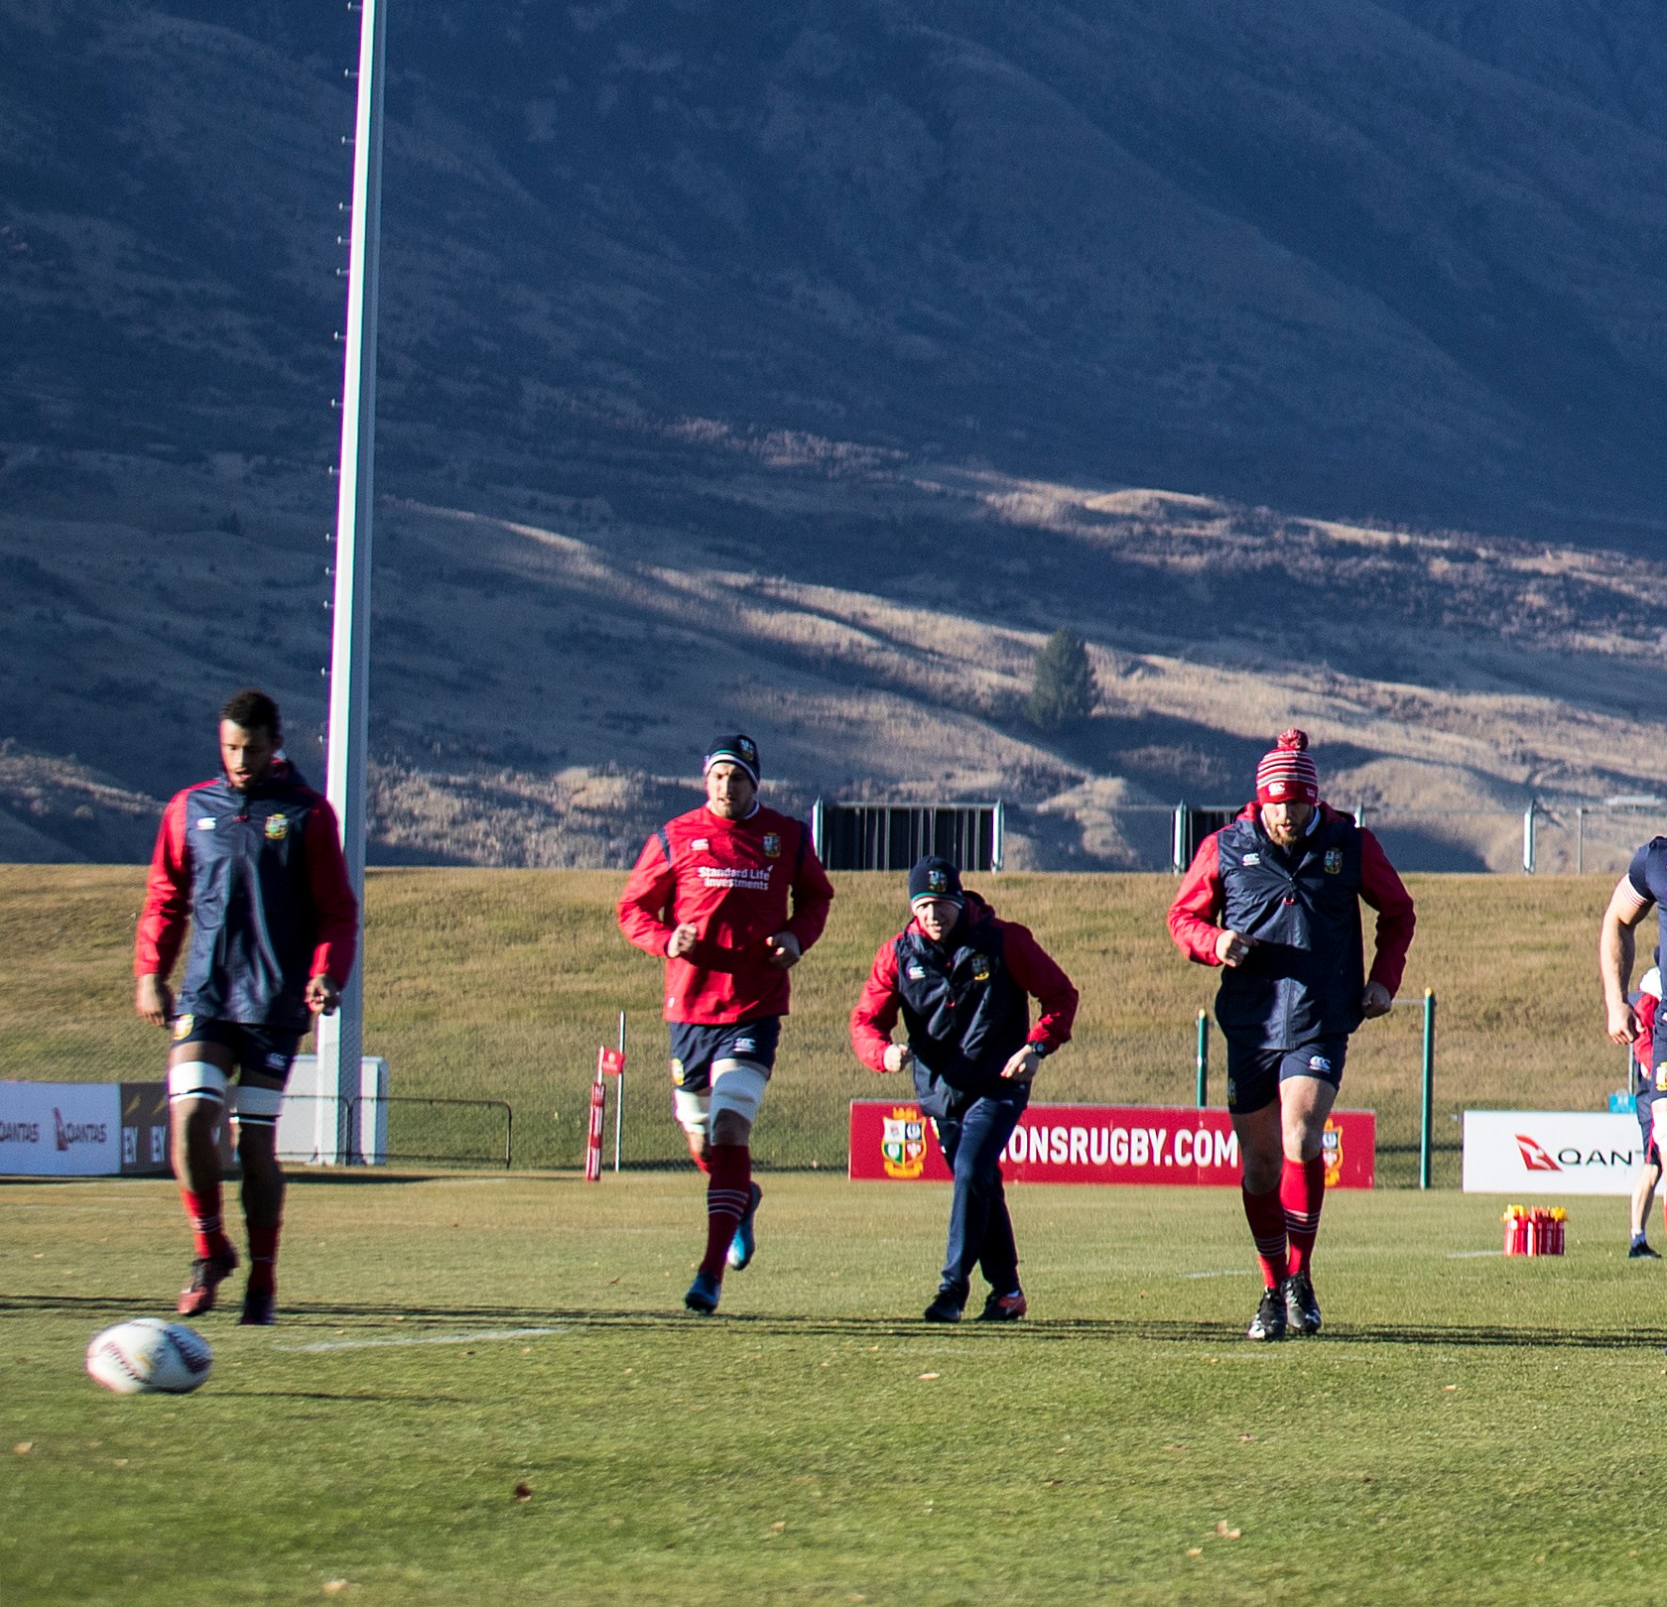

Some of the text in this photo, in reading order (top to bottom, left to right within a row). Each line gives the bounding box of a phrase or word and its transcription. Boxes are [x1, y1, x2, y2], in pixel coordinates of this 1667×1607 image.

[698, 866, 769, 880] Standard Life
[66, 1123, 106, 1143] QANTAS
[999, 1124, 1239, 1168] ONSRUGBY.COM
[1558, 1148, 1643, 1165] QAN
